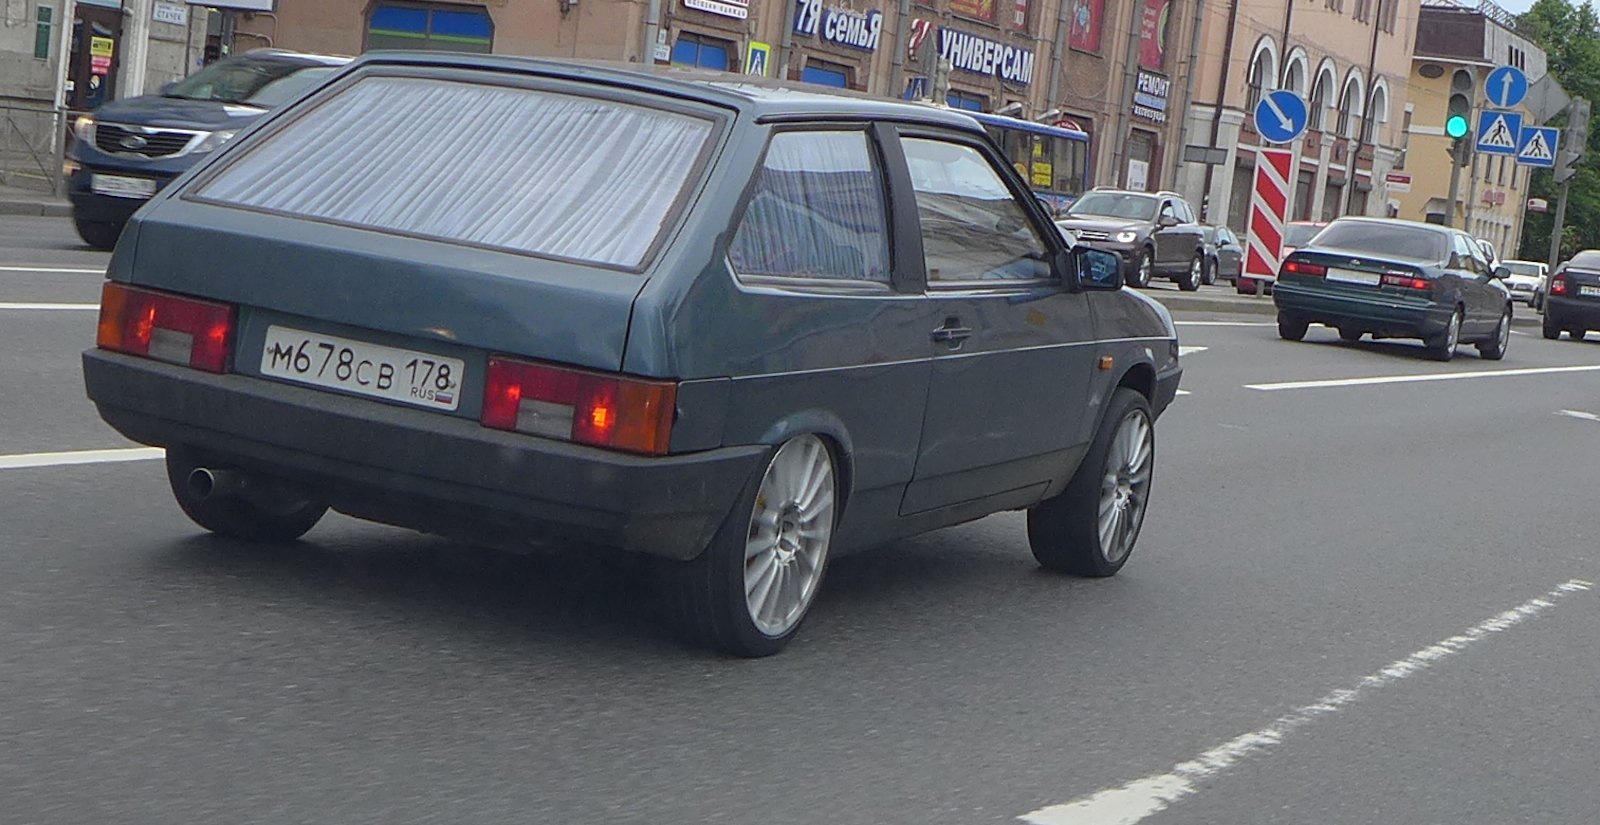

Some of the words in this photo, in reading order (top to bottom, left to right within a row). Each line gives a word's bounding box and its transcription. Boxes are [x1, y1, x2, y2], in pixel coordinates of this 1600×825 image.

[940, 29, 1034, 83] УНИВЕРСАМ
[1138, 72, 1170, 97] РЕМОНТ
[406, 358, 451, 390] 178
[410, 386, 435, 400] RUS
